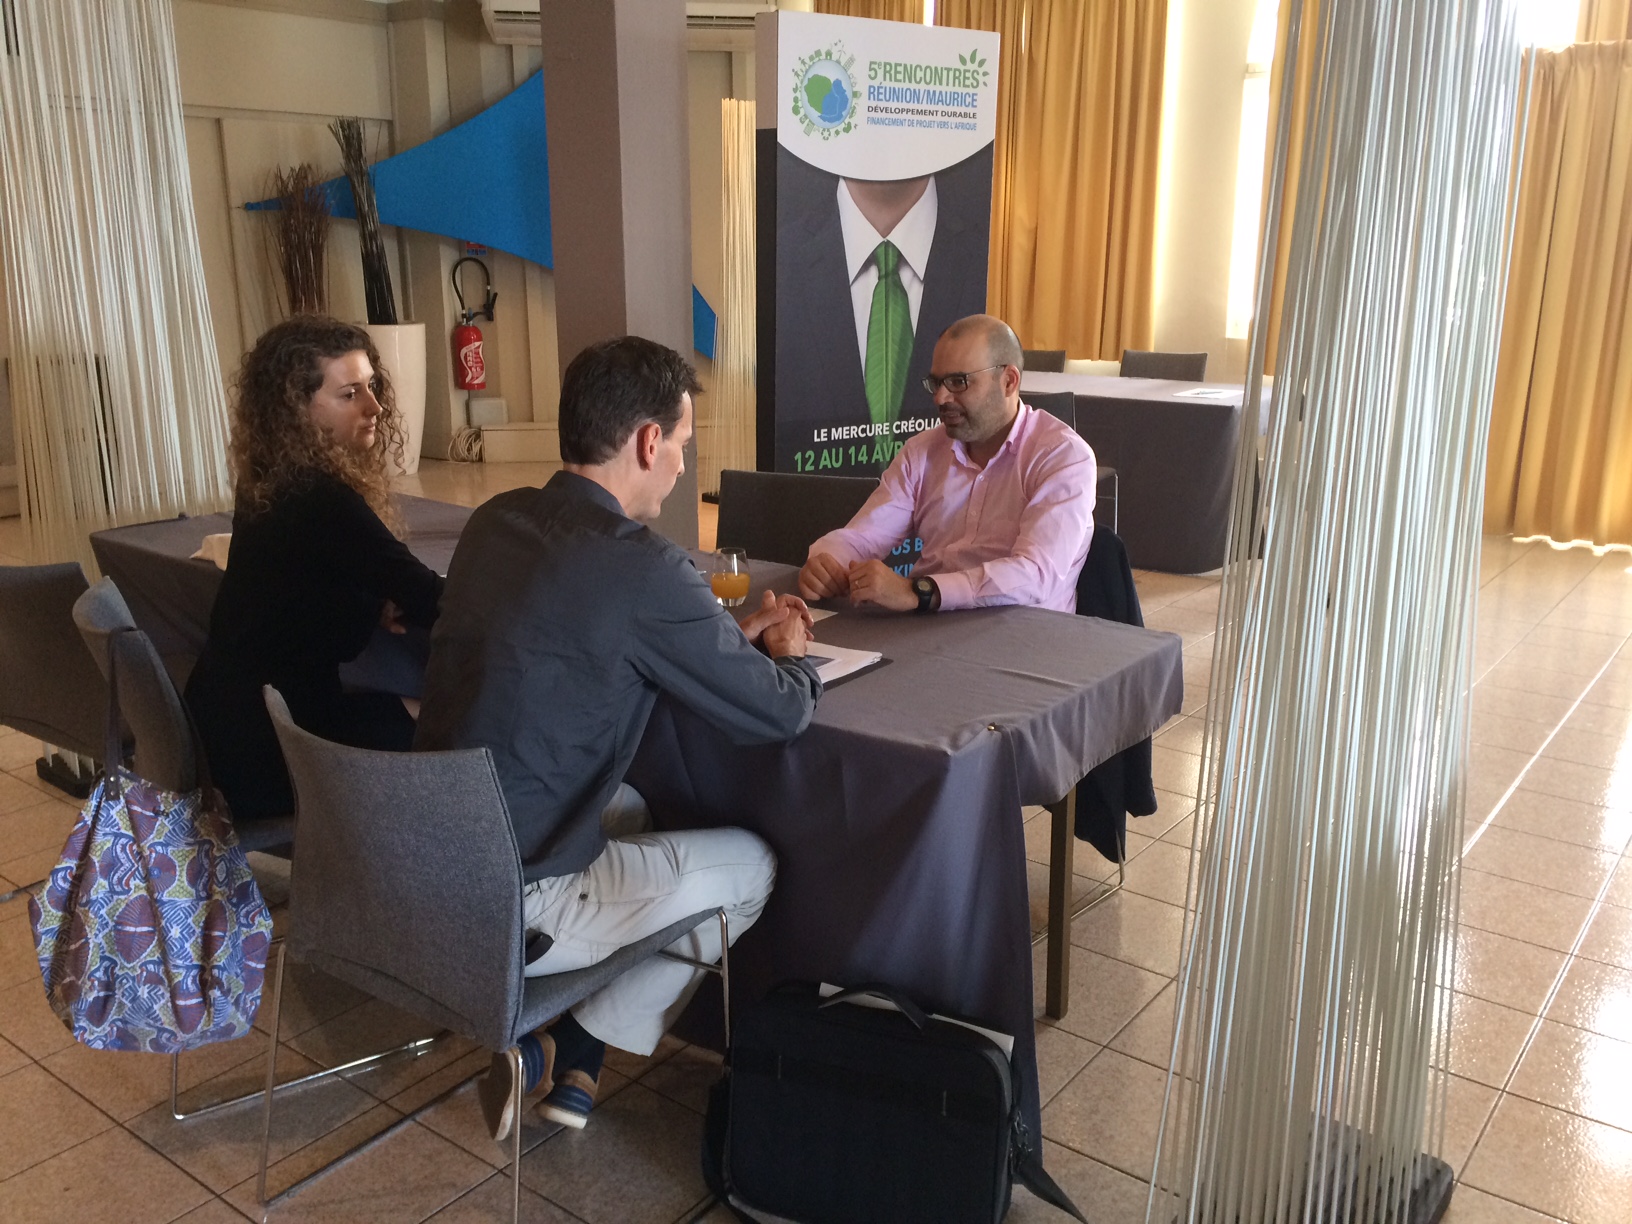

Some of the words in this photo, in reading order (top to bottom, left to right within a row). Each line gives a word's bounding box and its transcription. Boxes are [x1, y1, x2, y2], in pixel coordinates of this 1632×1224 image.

[883, 62, 980, 89] RENCONTRES
[867, 82, 978, 108] RÉUNION/MAURICE
[867, 105, 939, 117] DÉVELOPPEMENT
[940, 110, 977, 119] DURABLE
[866, 117, 906, 127] FINANCEMENT
[907, 119, 915, 127] DE
[915, 120, 937, 129] PROJET
[936, 121, 949, 129] VERS
[950, 122, 977, 131] L'AFRIQUE
[814, 429, 828, 442] LE
[831, 423, 890, 440] MERCURE
[794, 450, 815, 472] 12
[819, 447, 843, 470] AU
[848, 444, 868, 466] 14
[871, 441, 906, 464] AVR
